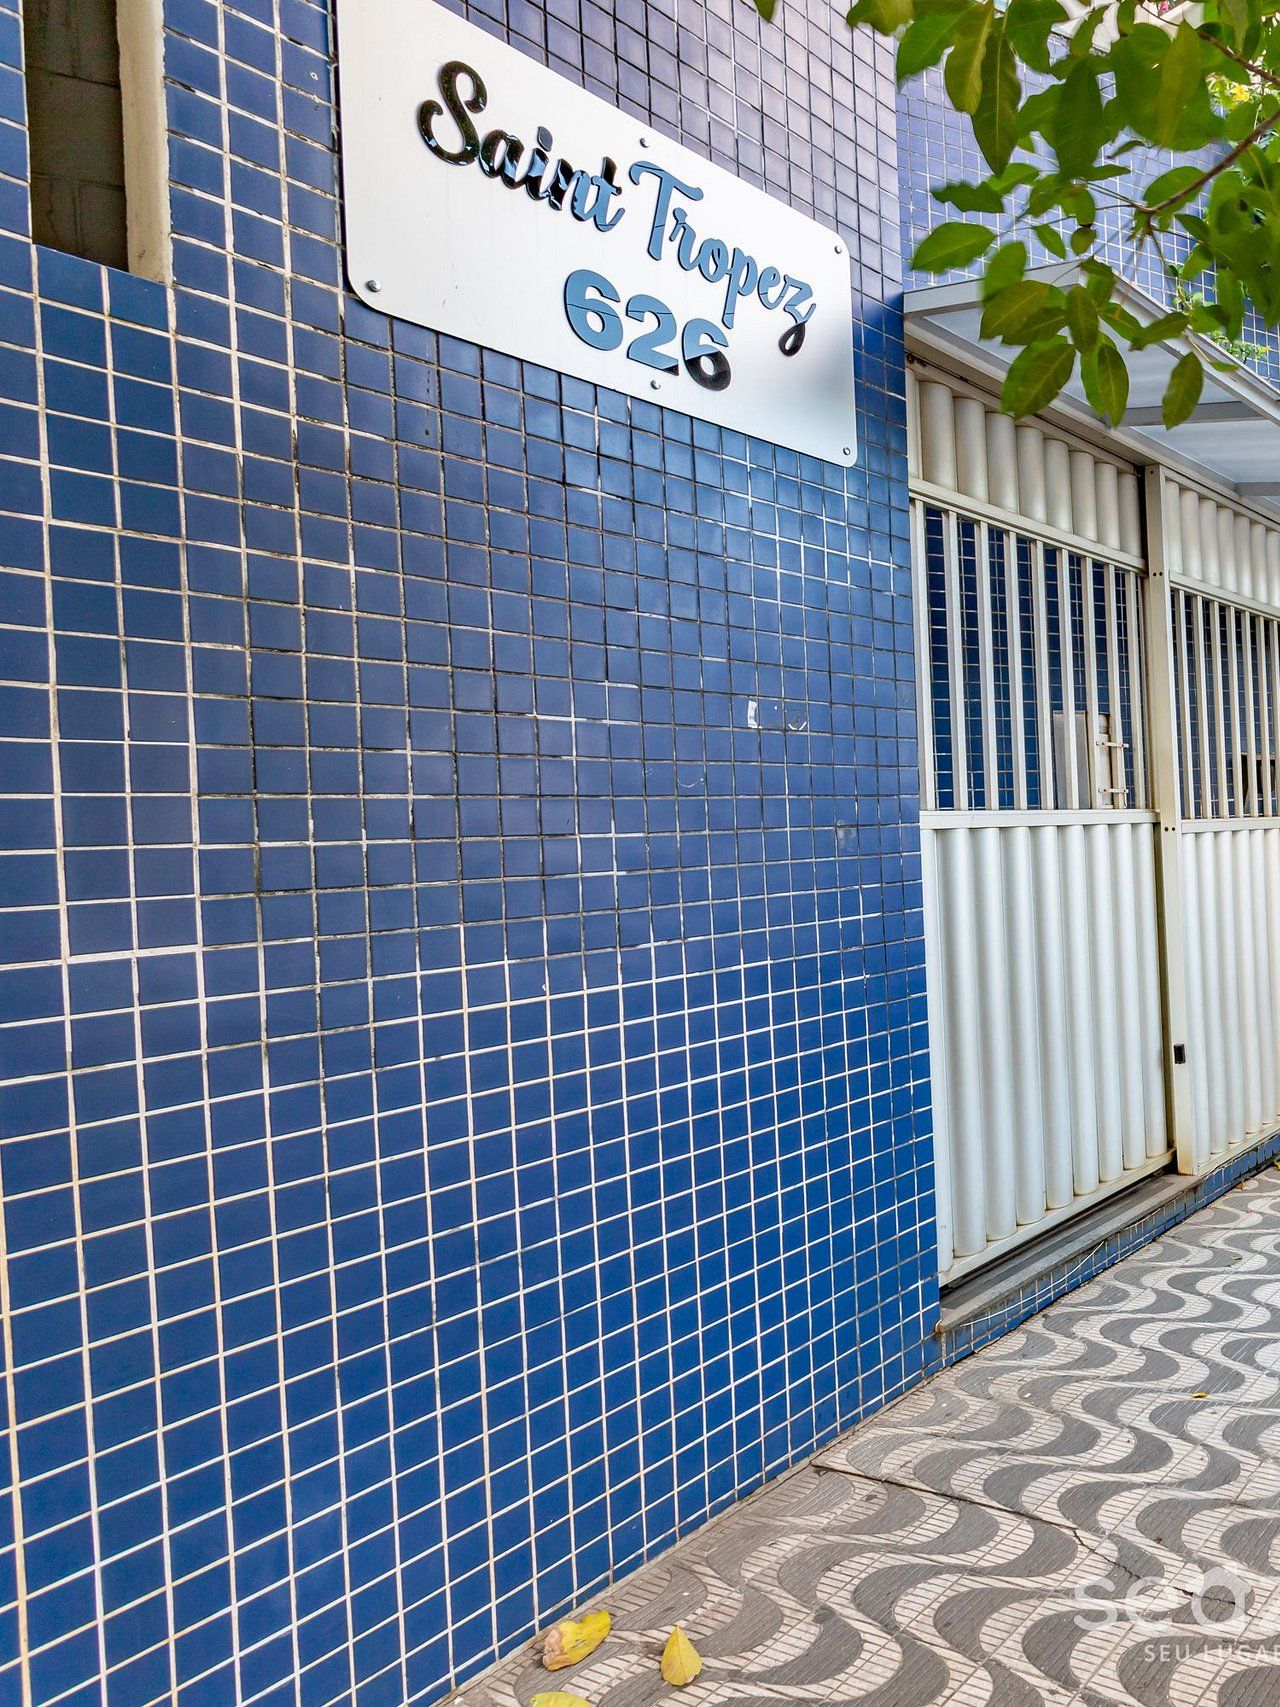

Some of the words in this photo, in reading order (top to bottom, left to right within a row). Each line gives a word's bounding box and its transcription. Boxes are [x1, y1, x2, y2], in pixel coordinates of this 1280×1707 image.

[416, 60, 626, 232] Saint
[628, 160, 817, 357] Tropez
[563, 268, 733, 391] 626
